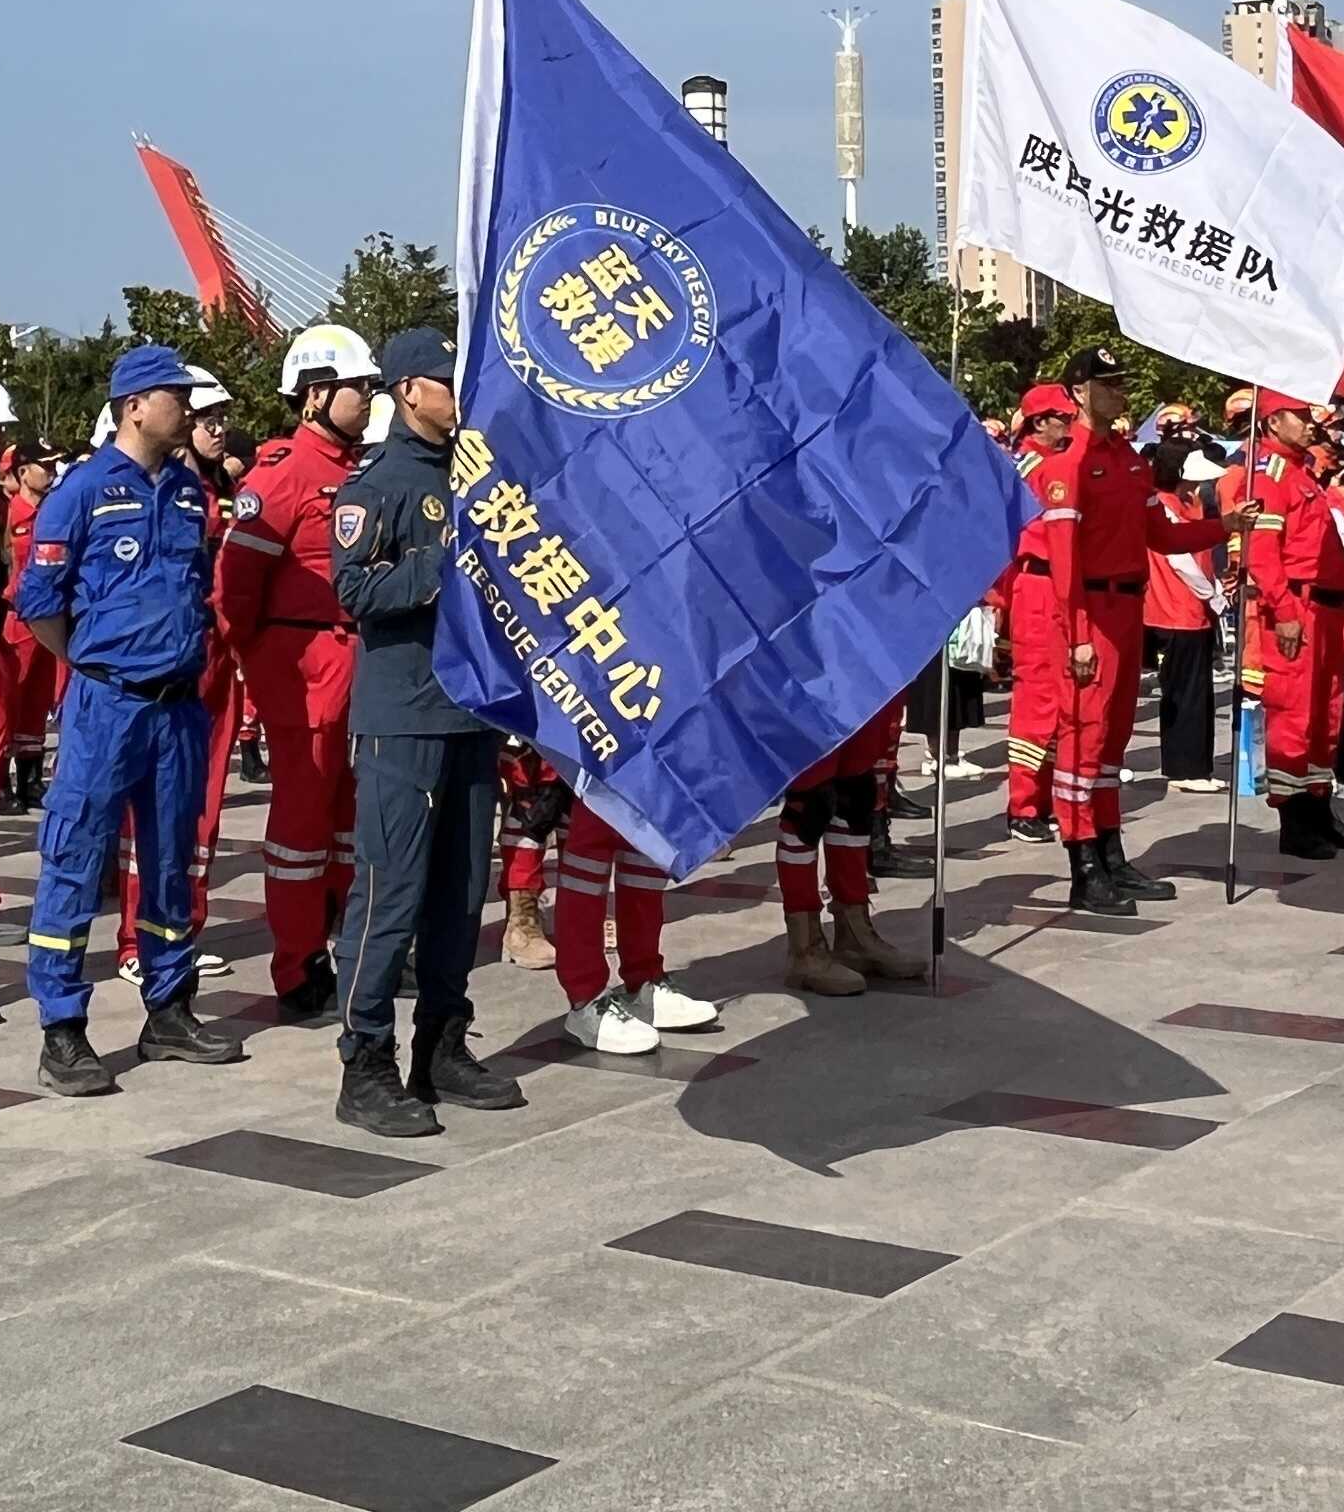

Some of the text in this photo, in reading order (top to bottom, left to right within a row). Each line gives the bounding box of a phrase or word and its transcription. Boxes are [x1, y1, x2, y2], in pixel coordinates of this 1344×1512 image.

[539, 272, 634, 374] 救援
[579, 243, 674, 340] 蓝天
[595, 210, 711, 348] BLUE SKY RESCUE
[1158, 255, 1225, 290] RESCUE
[1229, 281, 1275, 306] TEAM
[455, 547, 620, 762] RESCUE CENTER
